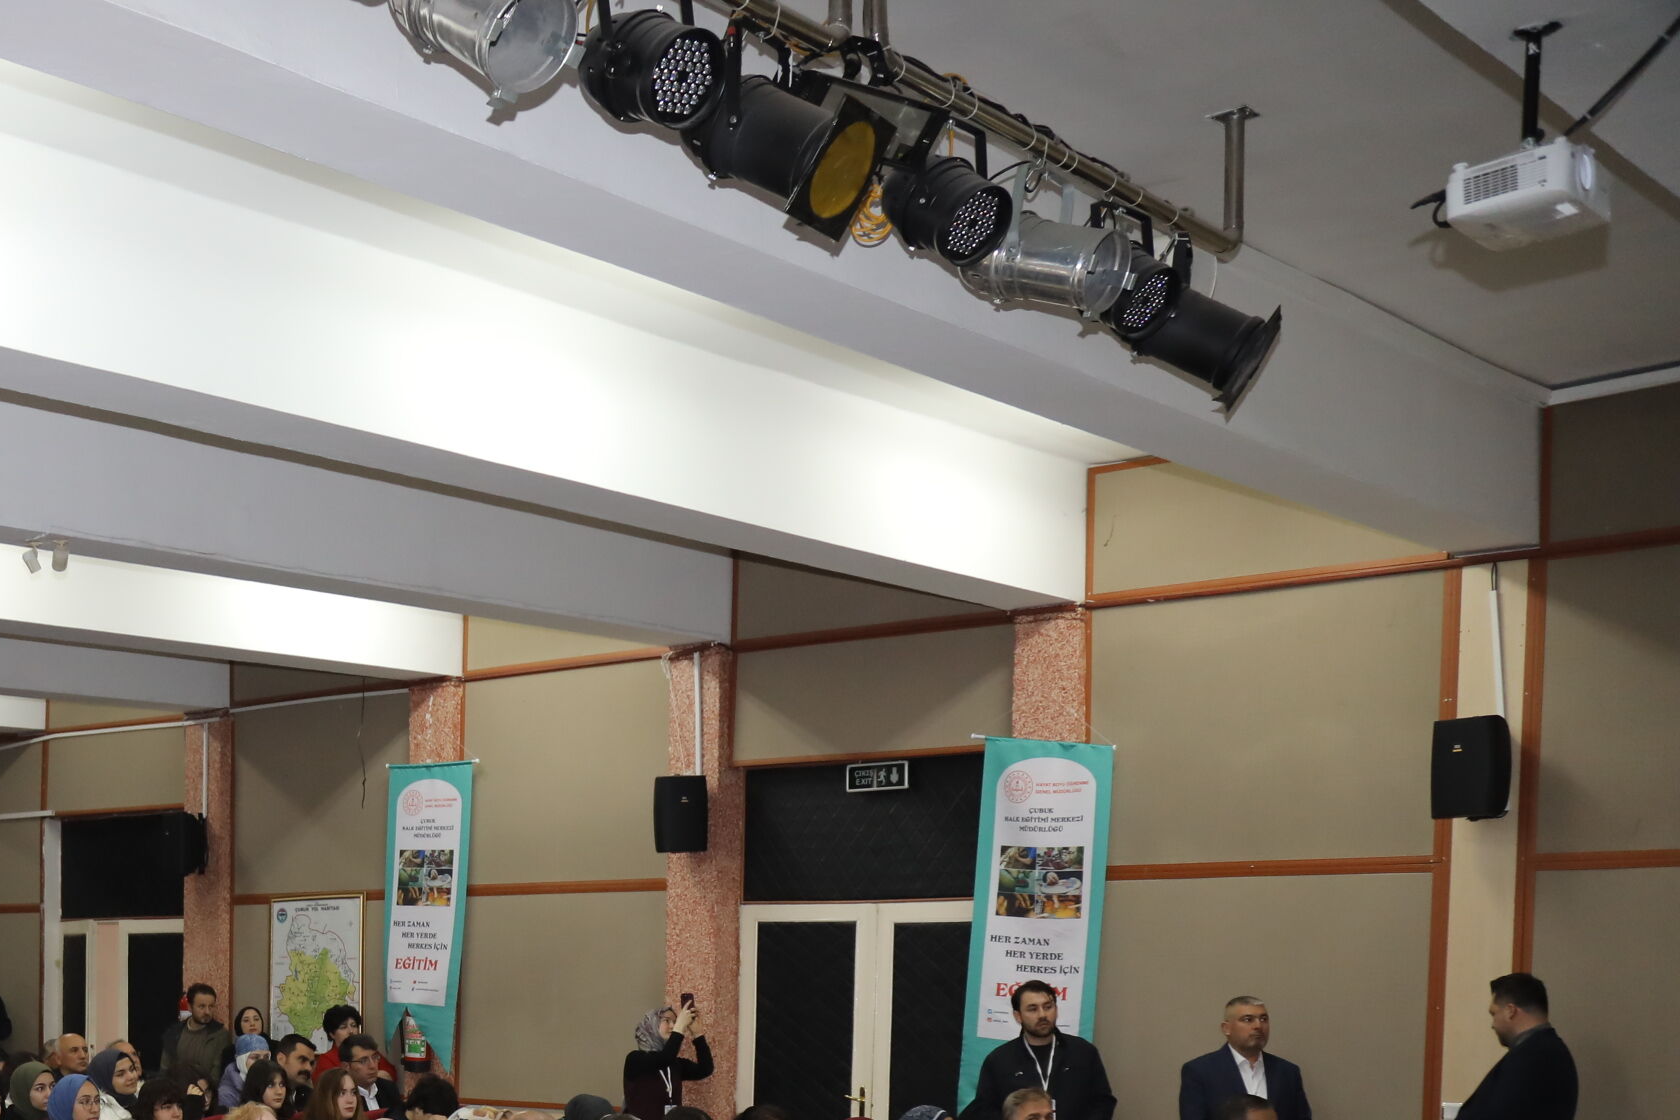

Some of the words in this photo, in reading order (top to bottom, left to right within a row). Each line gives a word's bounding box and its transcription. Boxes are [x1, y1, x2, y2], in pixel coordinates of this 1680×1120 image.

[855, 777, 872, 785] EXIT
[393, 920, 406, 928] HER
[407, 920, 430, 928] ZAMAN
[401, 931, 415, 939] HER
[990, 934, 1011, 944] HER
[1013, 936, 1050, 946] ZAMAN
[407, 942, 433, 950] HERKES
[433, 942, 449, 951] İÇİN
[1005, 949, 1026, 959] HER
[1028, 951, 1064, 961] YERDE
[394, 955, 439, 971] EĞİTİM
[1016, 964, 1057, 974] HERKES
[1059, 965, 1080, 976] İÇİN
